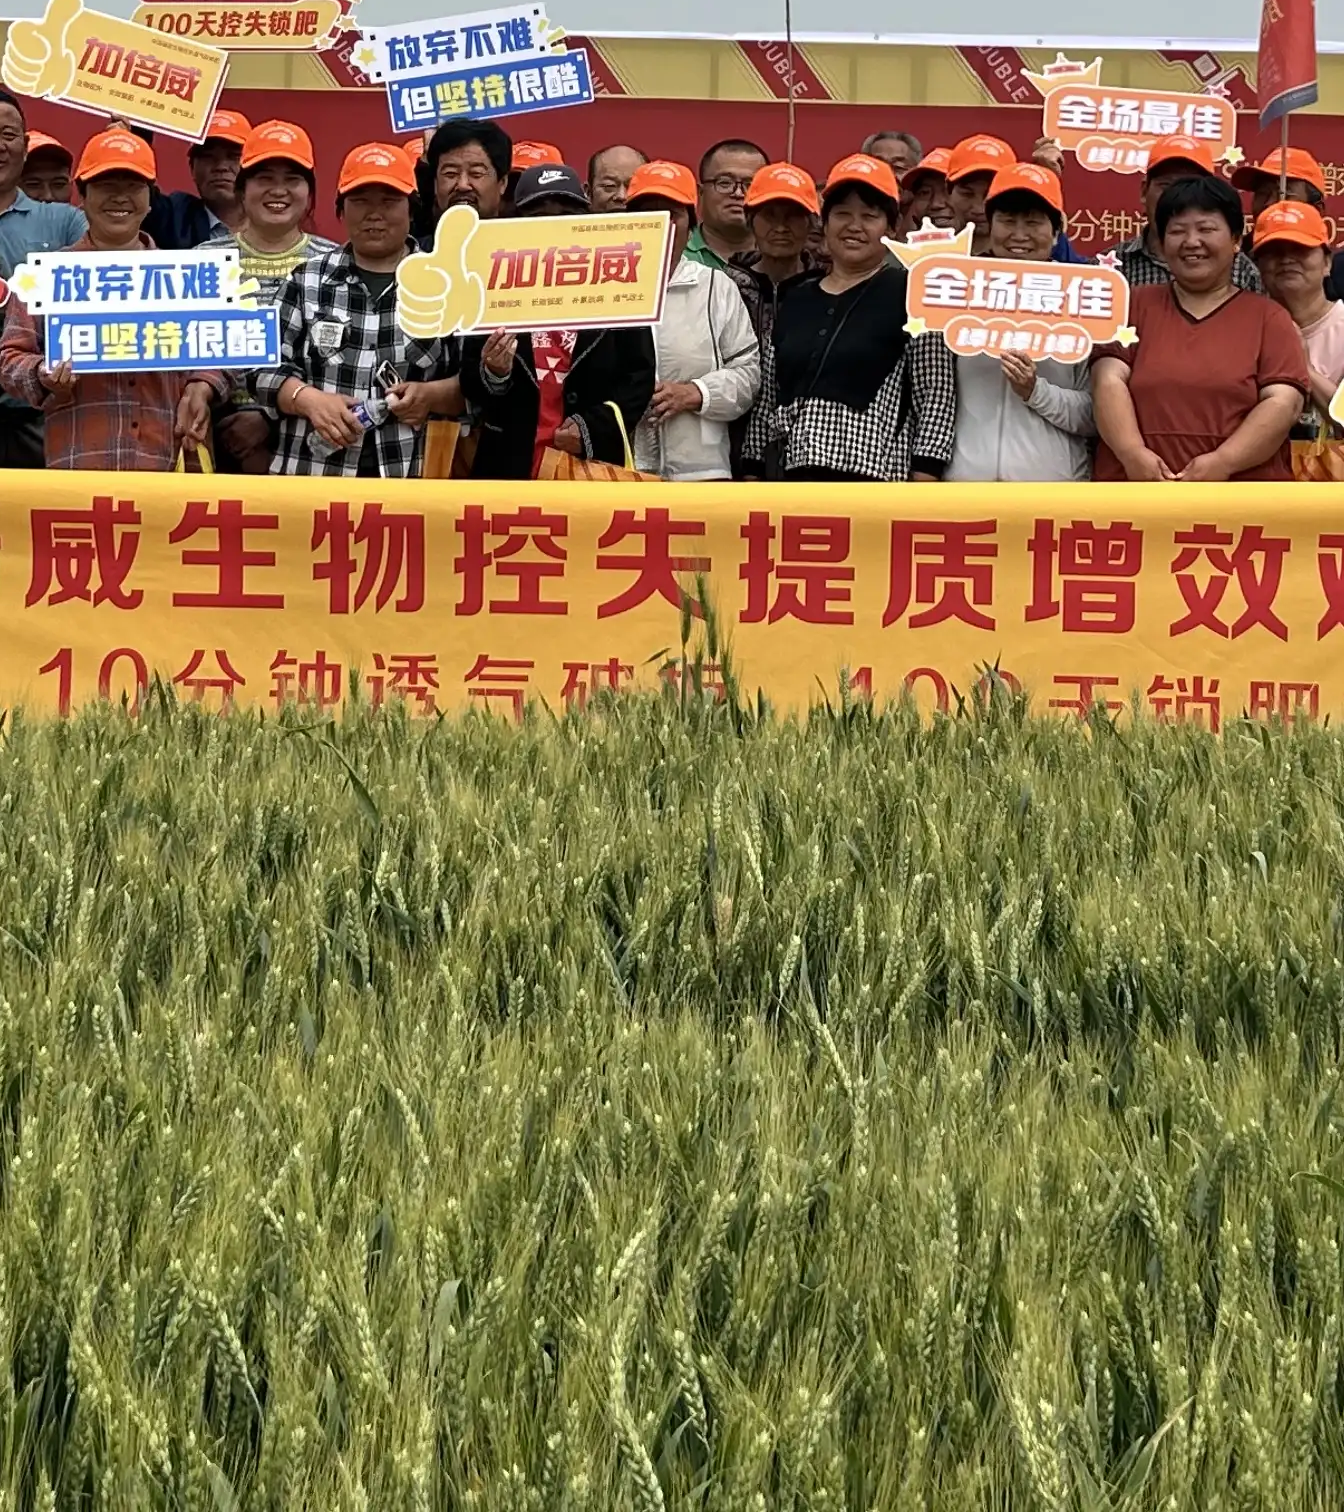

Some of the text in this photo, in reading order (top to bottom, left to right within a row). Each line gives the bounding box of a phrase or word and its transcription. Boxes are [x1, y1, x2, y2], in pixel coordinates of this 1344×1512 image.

[141, 10, 320, 38] 100天控失锁肥
[386, 17, 535, 72] 放弃不难
[76, 36, 203, 104] 加倍威
[399, 62, 582, 122] 但坚持很酷
[1056, 94, 1223, 141] 全场最佳
[51, 263, 222, 303] 放弃不难
[486, 241, 643, 291] 加倍威
[921, 266, 1114, 320] 全场最佳
[57, 318, 270, 362] 但坚持很酷
